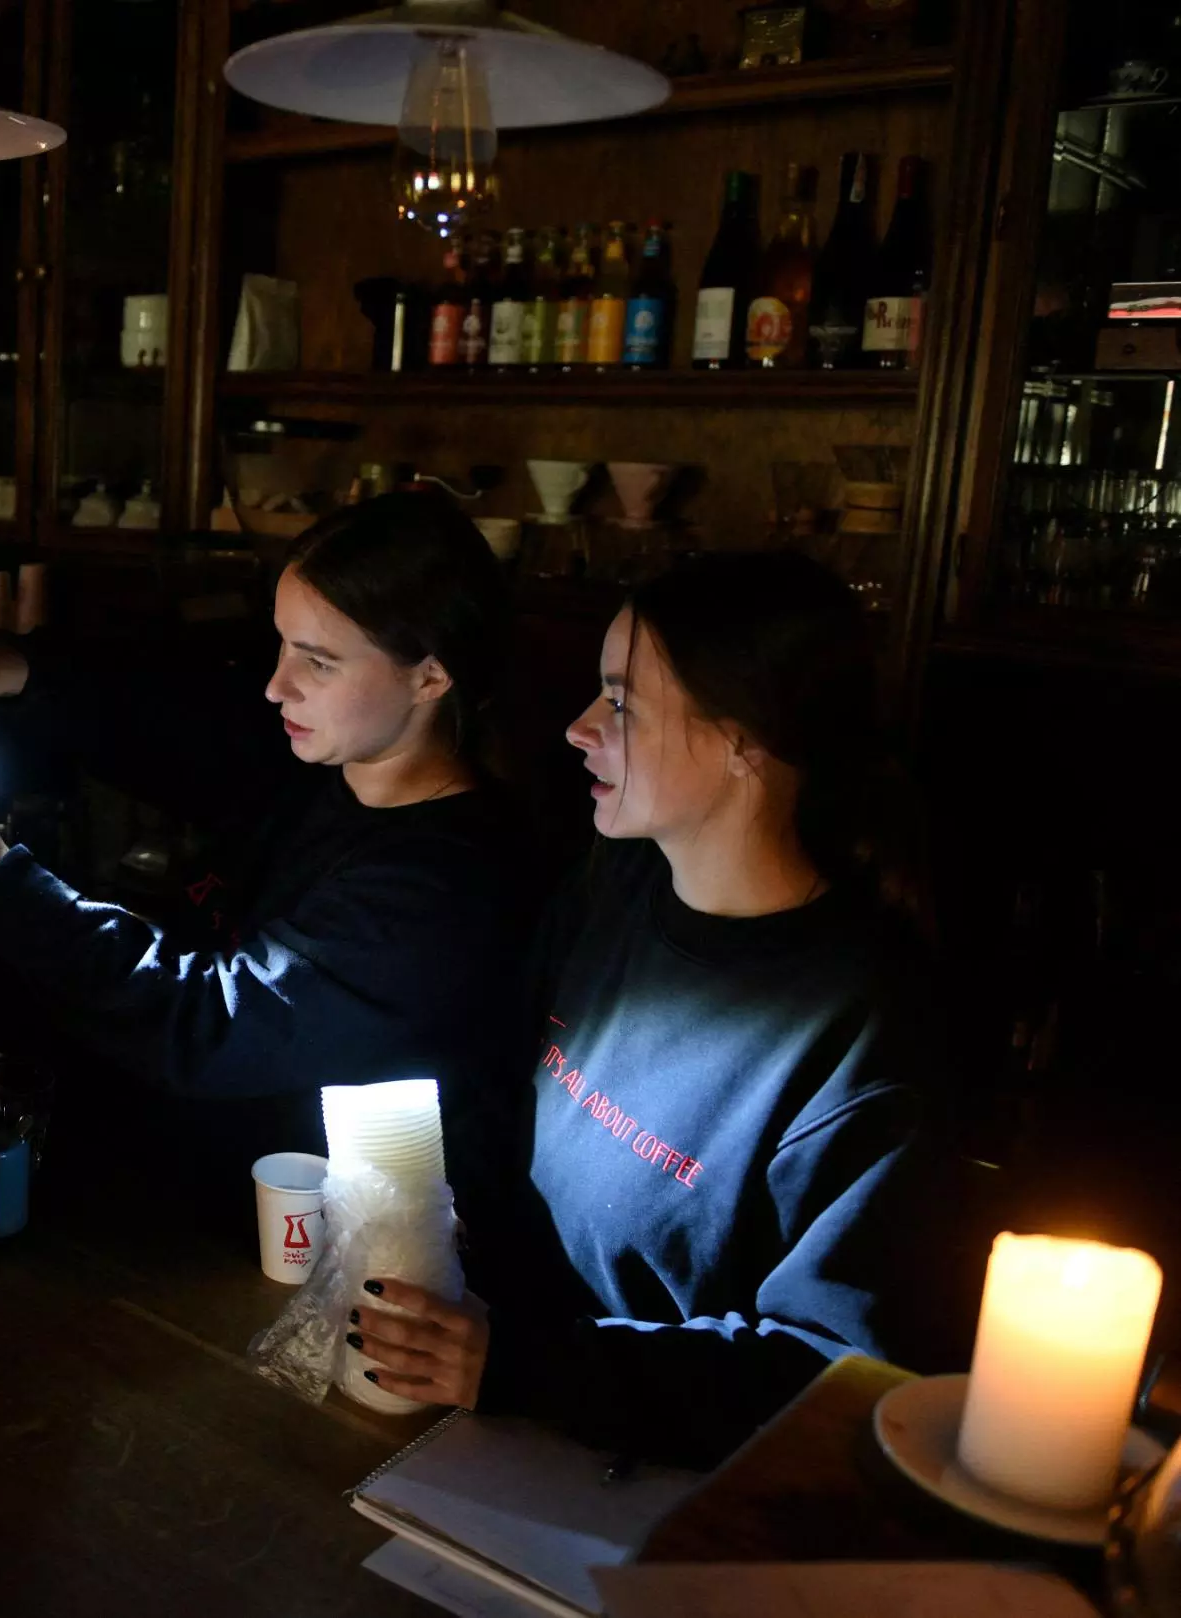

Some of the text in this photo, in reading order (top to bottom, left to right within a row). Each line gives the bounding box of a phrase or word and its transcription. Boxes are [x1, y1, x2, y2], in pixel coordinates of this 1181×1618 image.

[559, 1069, 587, 1102] ALL
[581, 1090, 638, 1142] ABOUT
[631, 1129, 705, 1190] COFFEE
